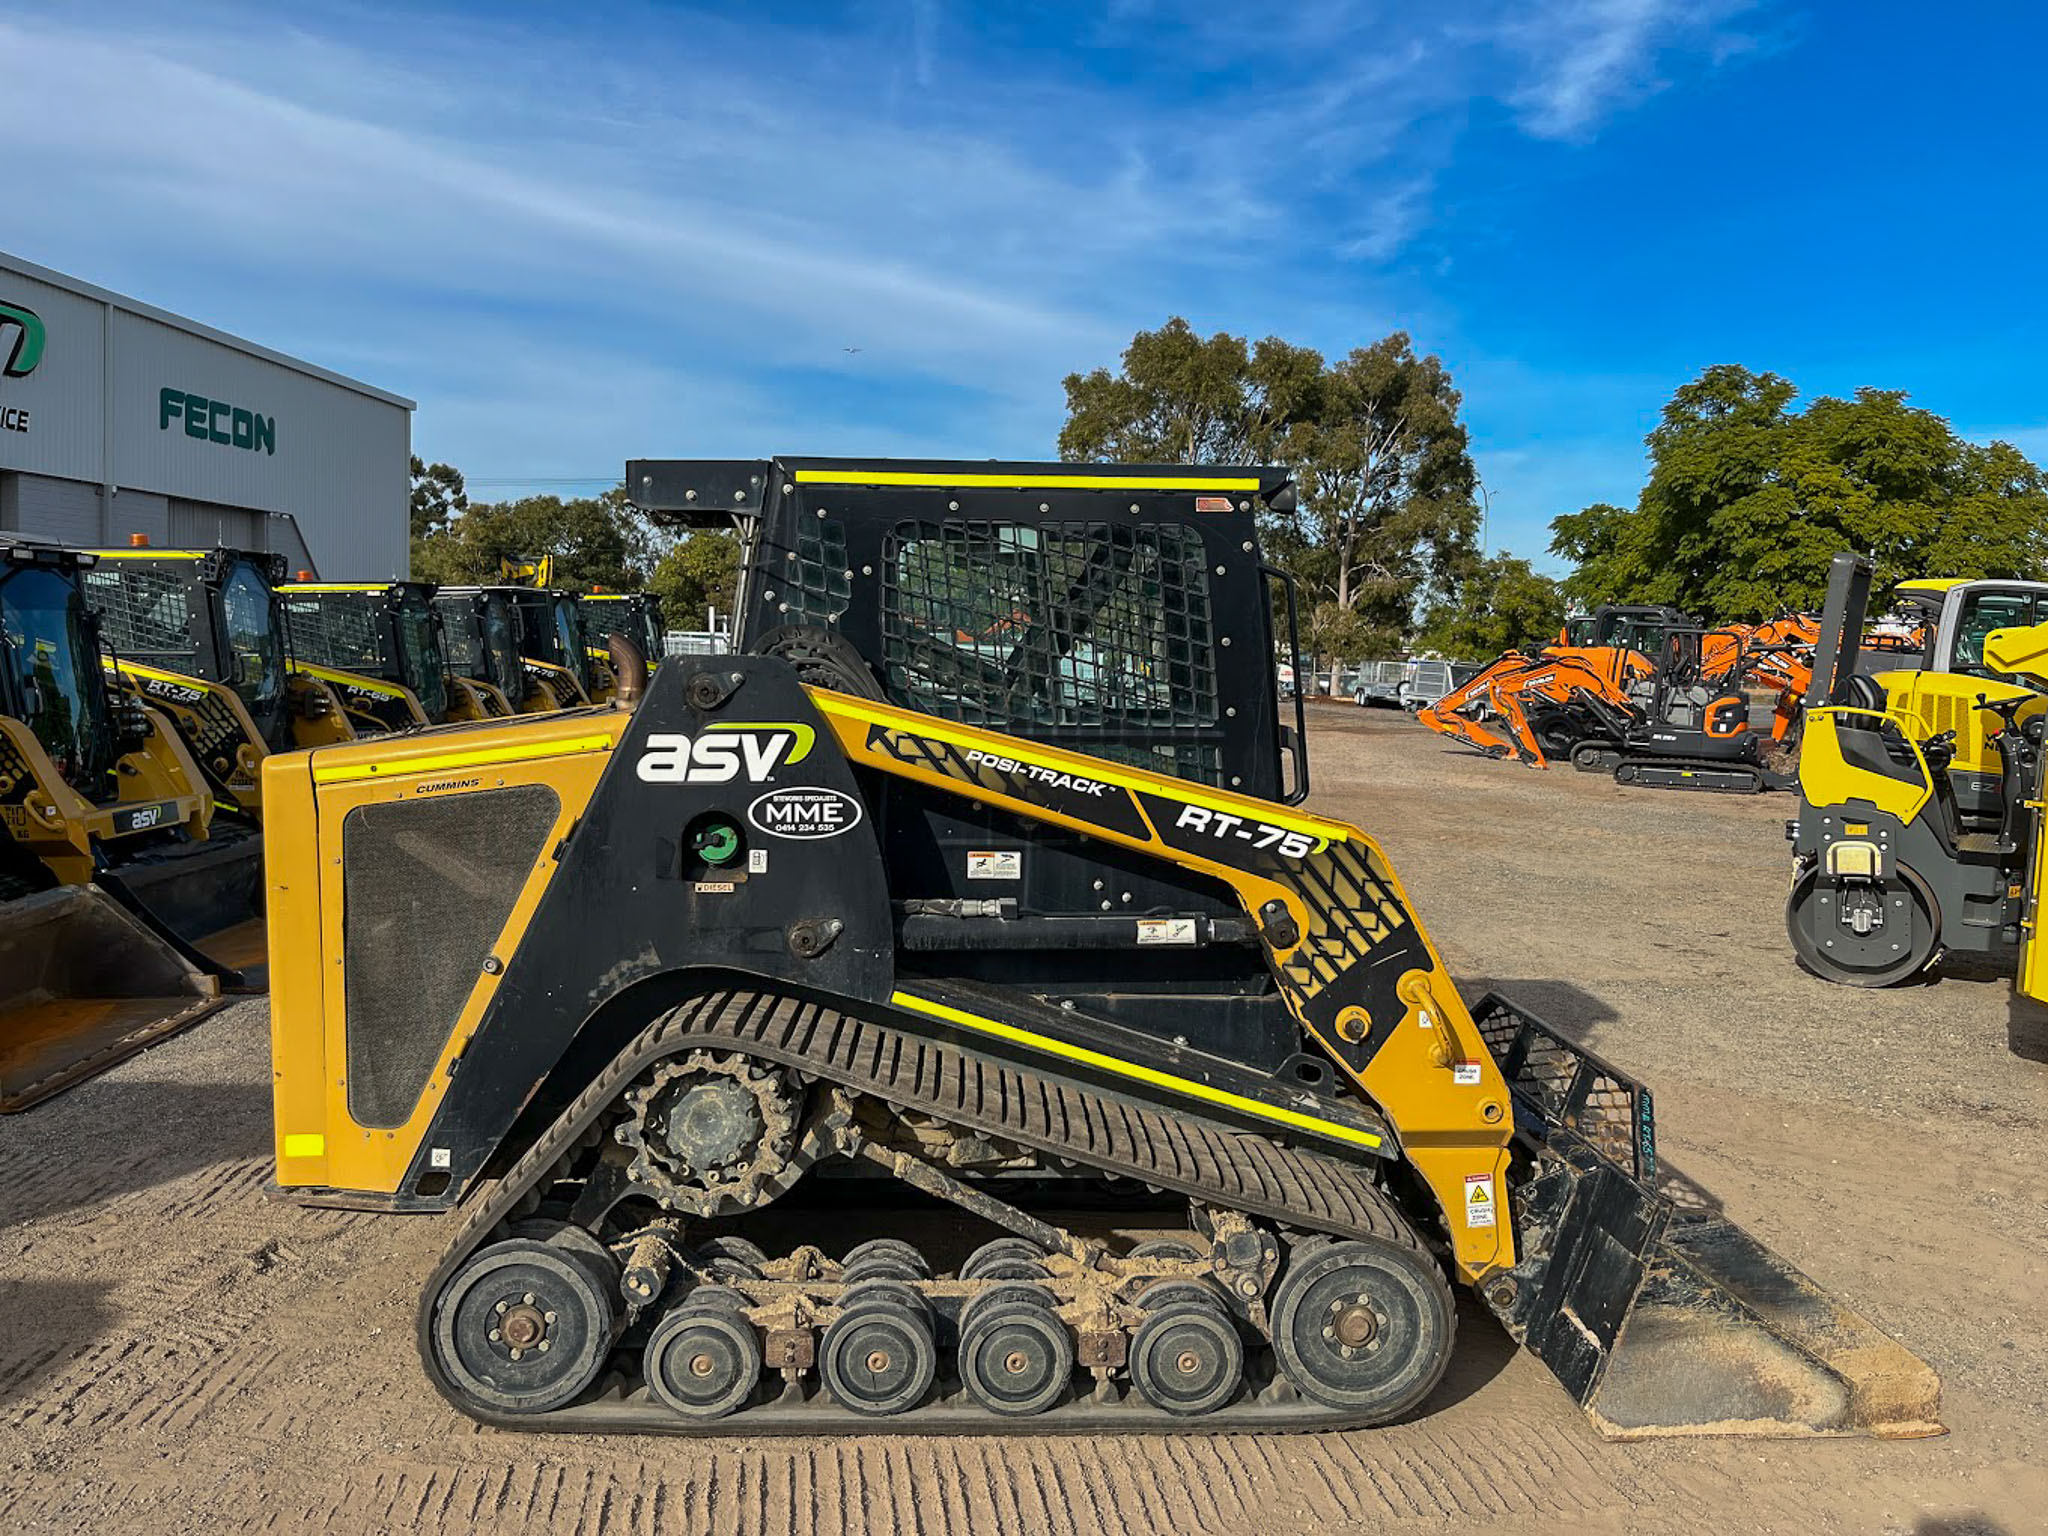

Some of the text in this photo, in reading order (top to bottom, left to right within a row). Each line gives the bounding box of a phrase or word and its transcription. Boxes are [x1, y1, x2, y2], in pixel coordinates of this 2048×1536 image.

[0, 406, 30, 433] ICE
[160, 387, 276, 456] FECON
[146, 679, 202, 701] RT-75
[346, 685, 390, 702] RT-65
[965, 749, 1105, 798] POSI-TRACK
[416, 778, 481, 795] CUMMINS
[765, 802, 844, 823] MME
[775, 823, 835, 832] 0414 234 535
[1175, 805, 1313, 858] RT-75
[703, 883, 732, 892] DIESEL
